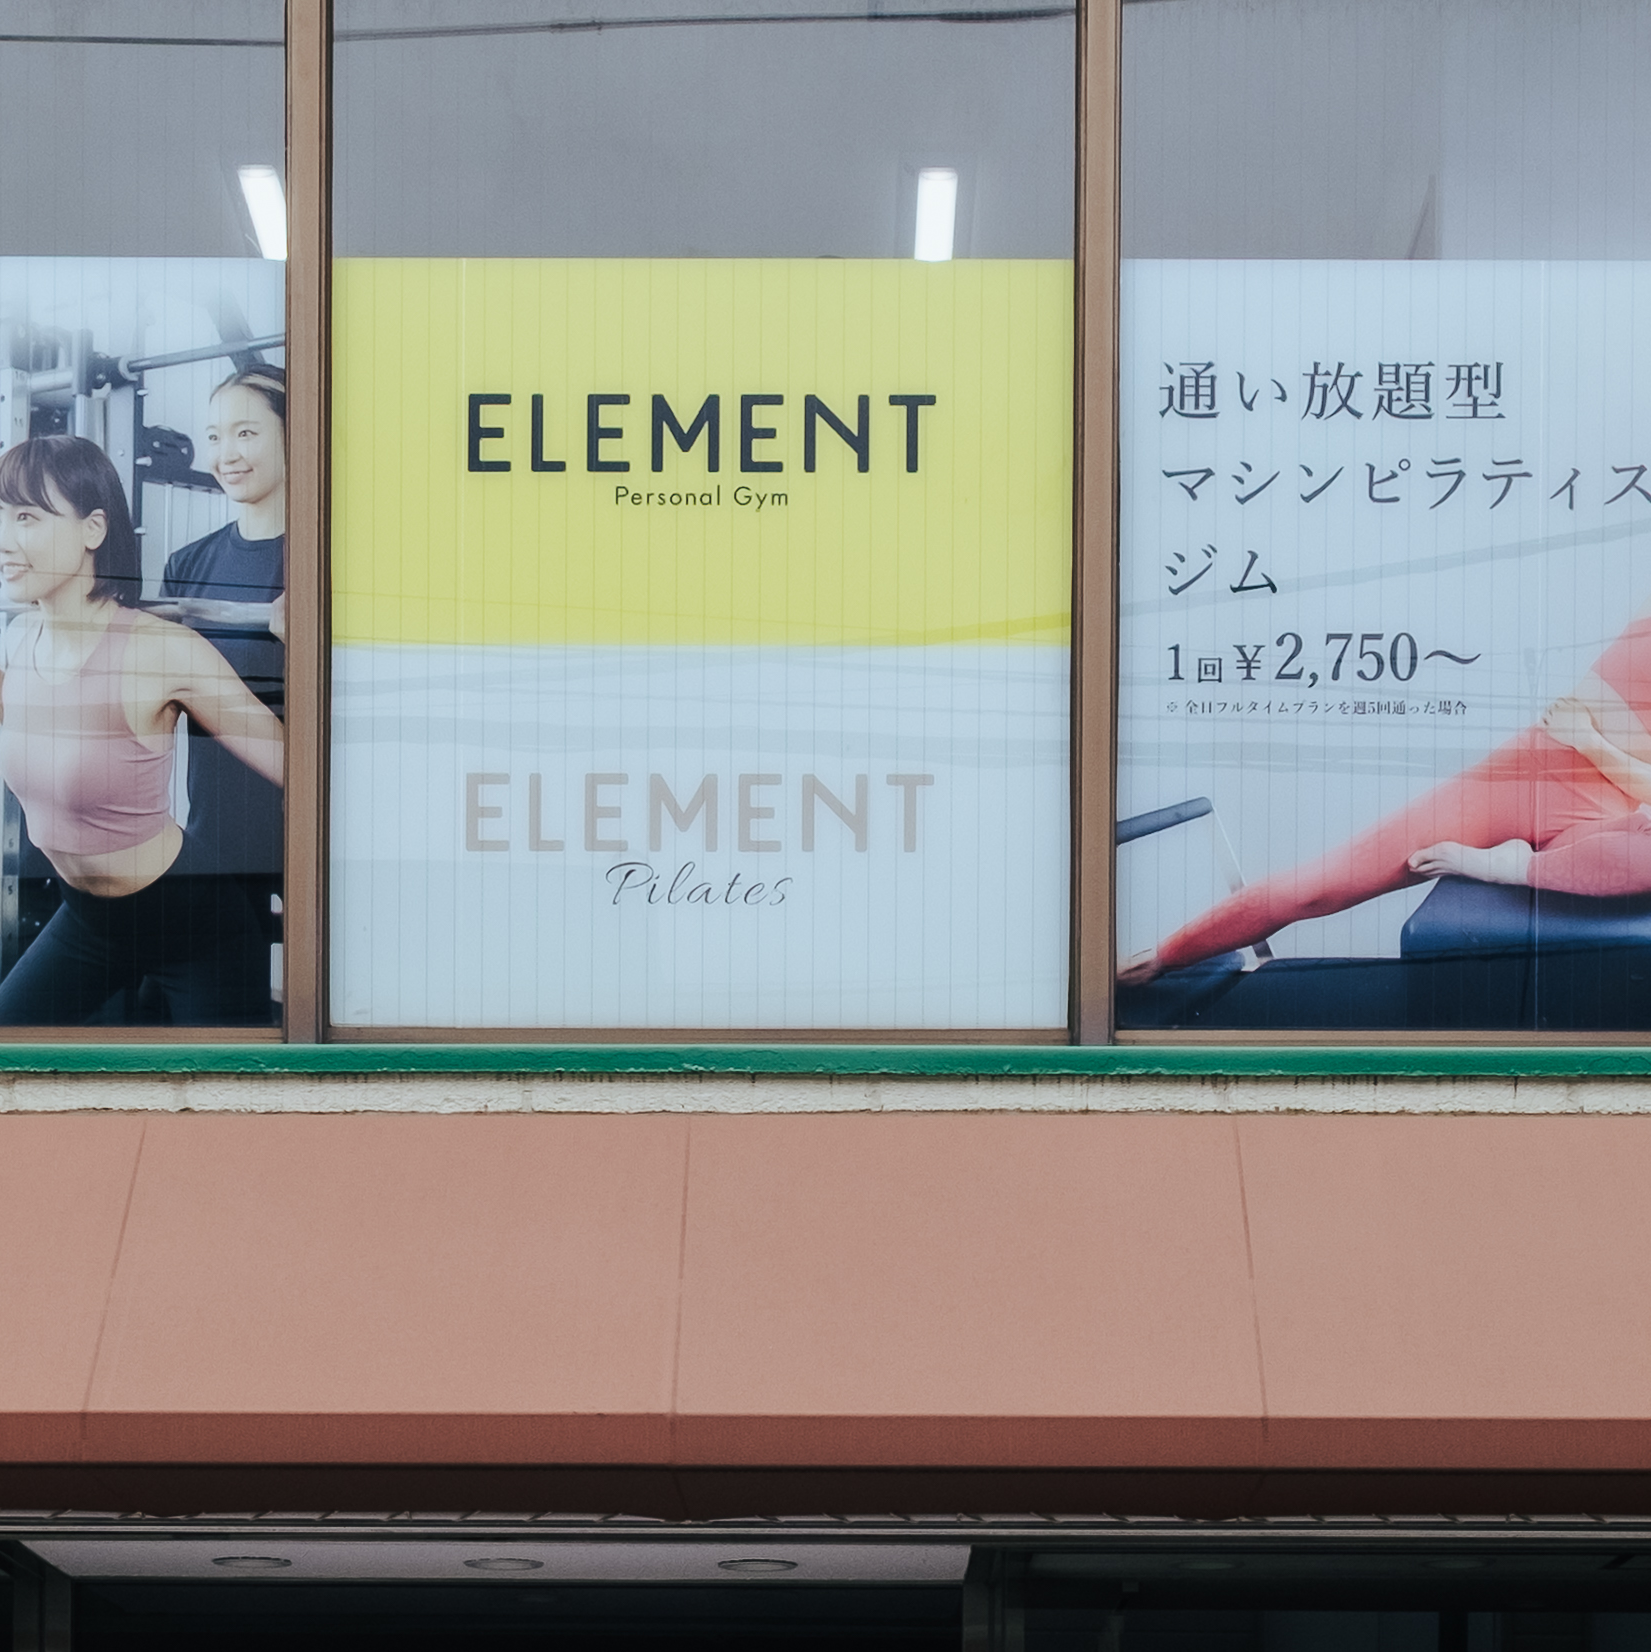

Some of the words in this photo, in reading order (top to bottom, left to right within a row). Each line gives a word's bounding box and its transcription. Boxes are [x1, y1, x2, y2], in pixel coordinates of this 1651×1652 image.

[1159, 362, 1505, 420] 通い放題型
[468, 394, 936, 473] ELEMENT
[616, 485, 720, 505] Personal
[734, 486, 787, 509] Gym
[1166, 545, 1277, 595] ジム
[464, 772, 935, 853] ELEMENT
[606, 862, 791, 905] Pilates
